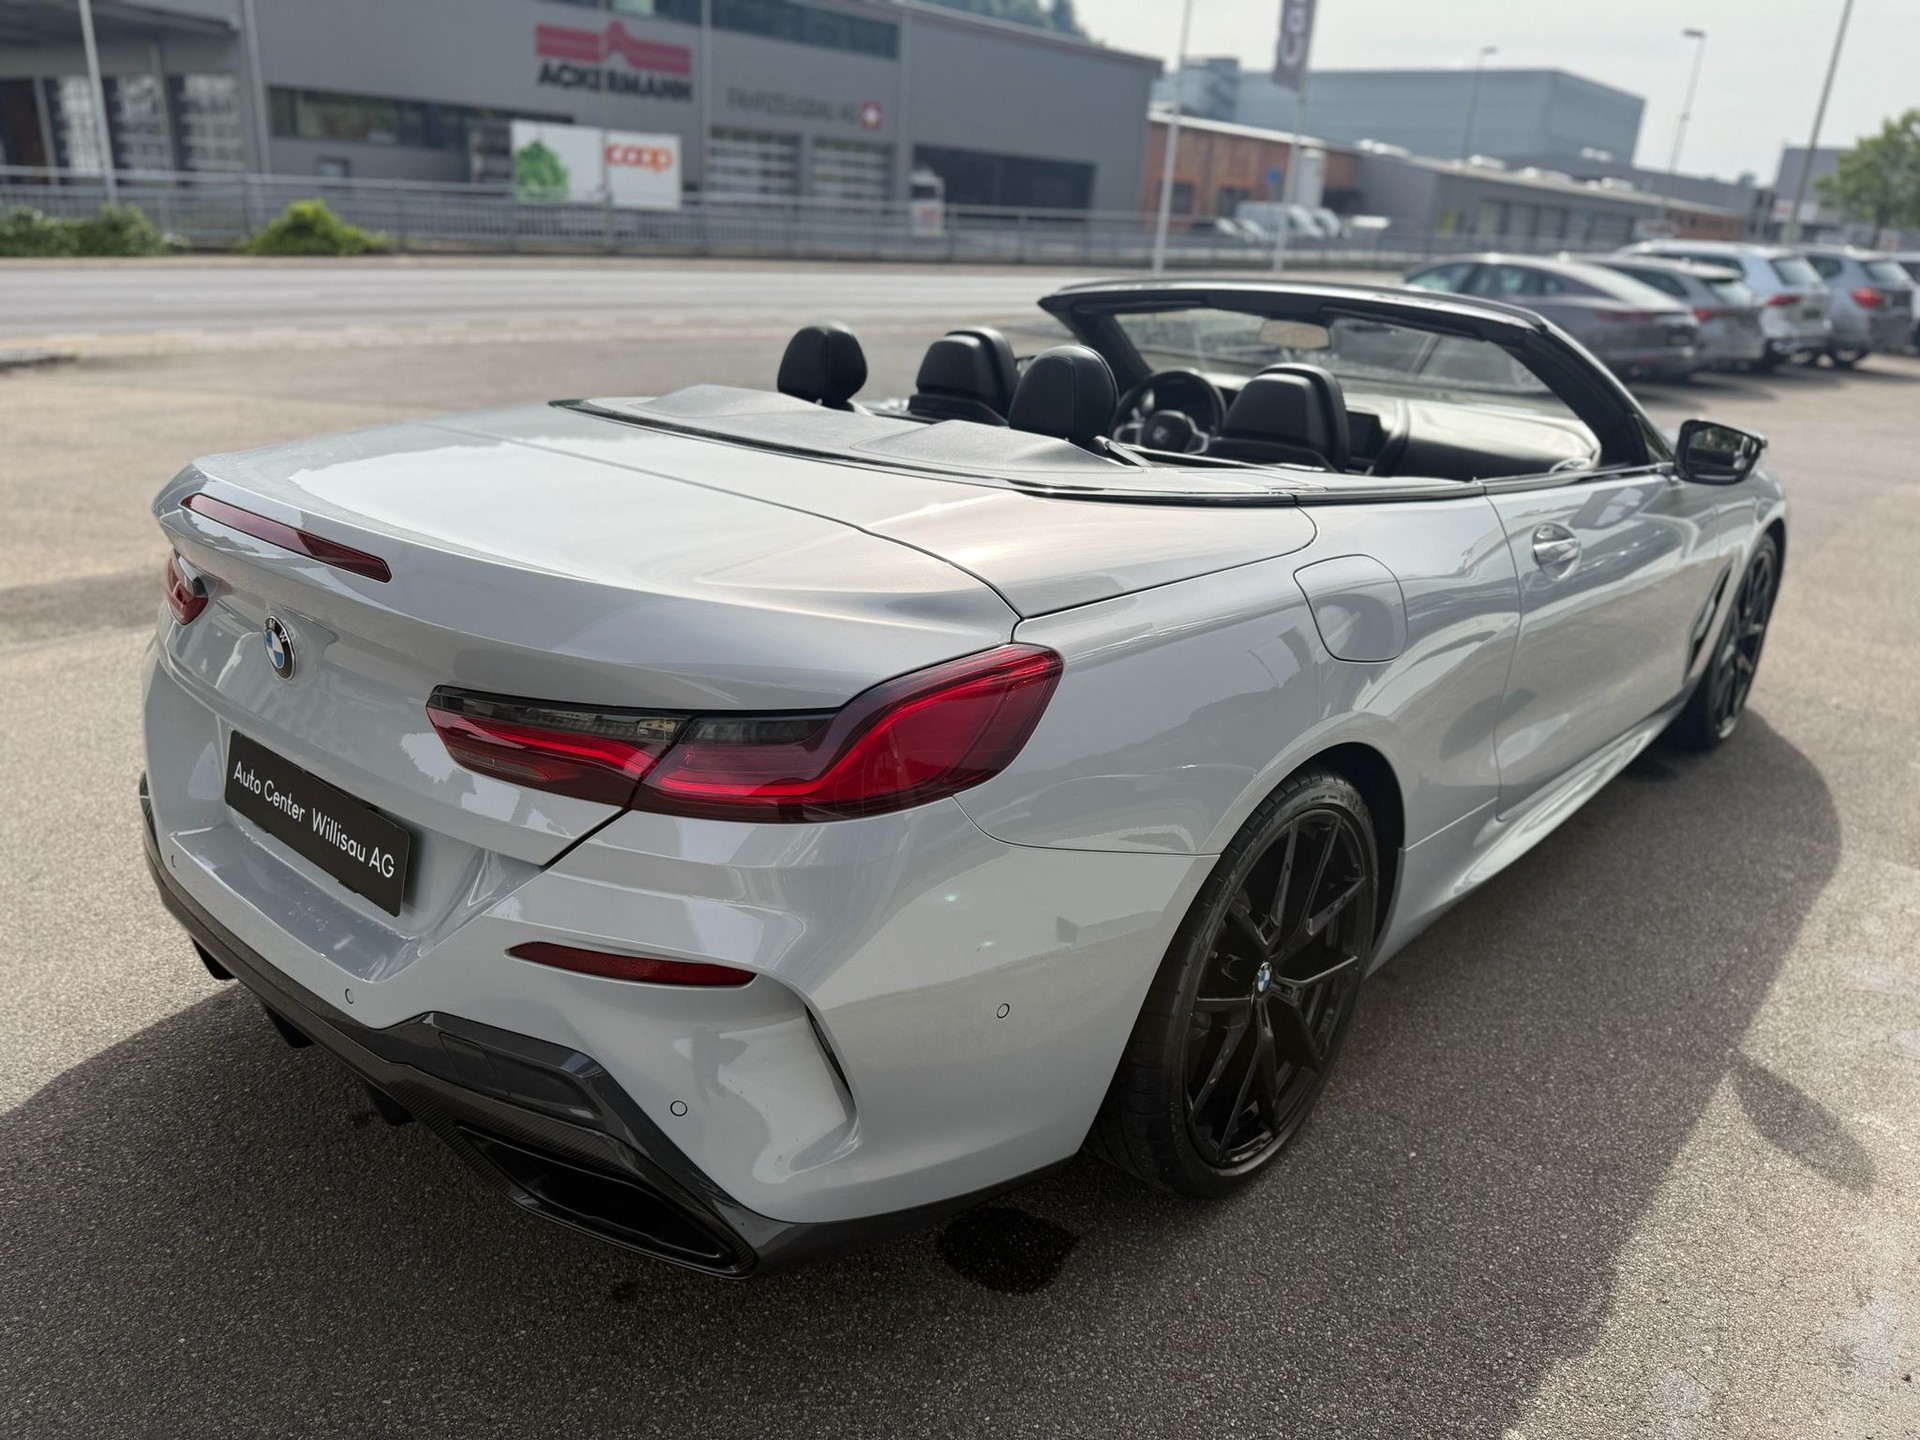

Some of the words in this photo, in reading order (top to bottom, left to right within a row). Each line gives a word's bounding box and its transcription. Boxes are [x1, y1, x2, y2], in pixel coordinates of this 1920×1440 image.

[538, 62, 692, 101] ACKERMANN
[233, 760, 262, 795] Auto
[264, 779, 306, 823] Center
[312, 807, 366, 863] Willisau
[369, 847, 395, 879] AG
